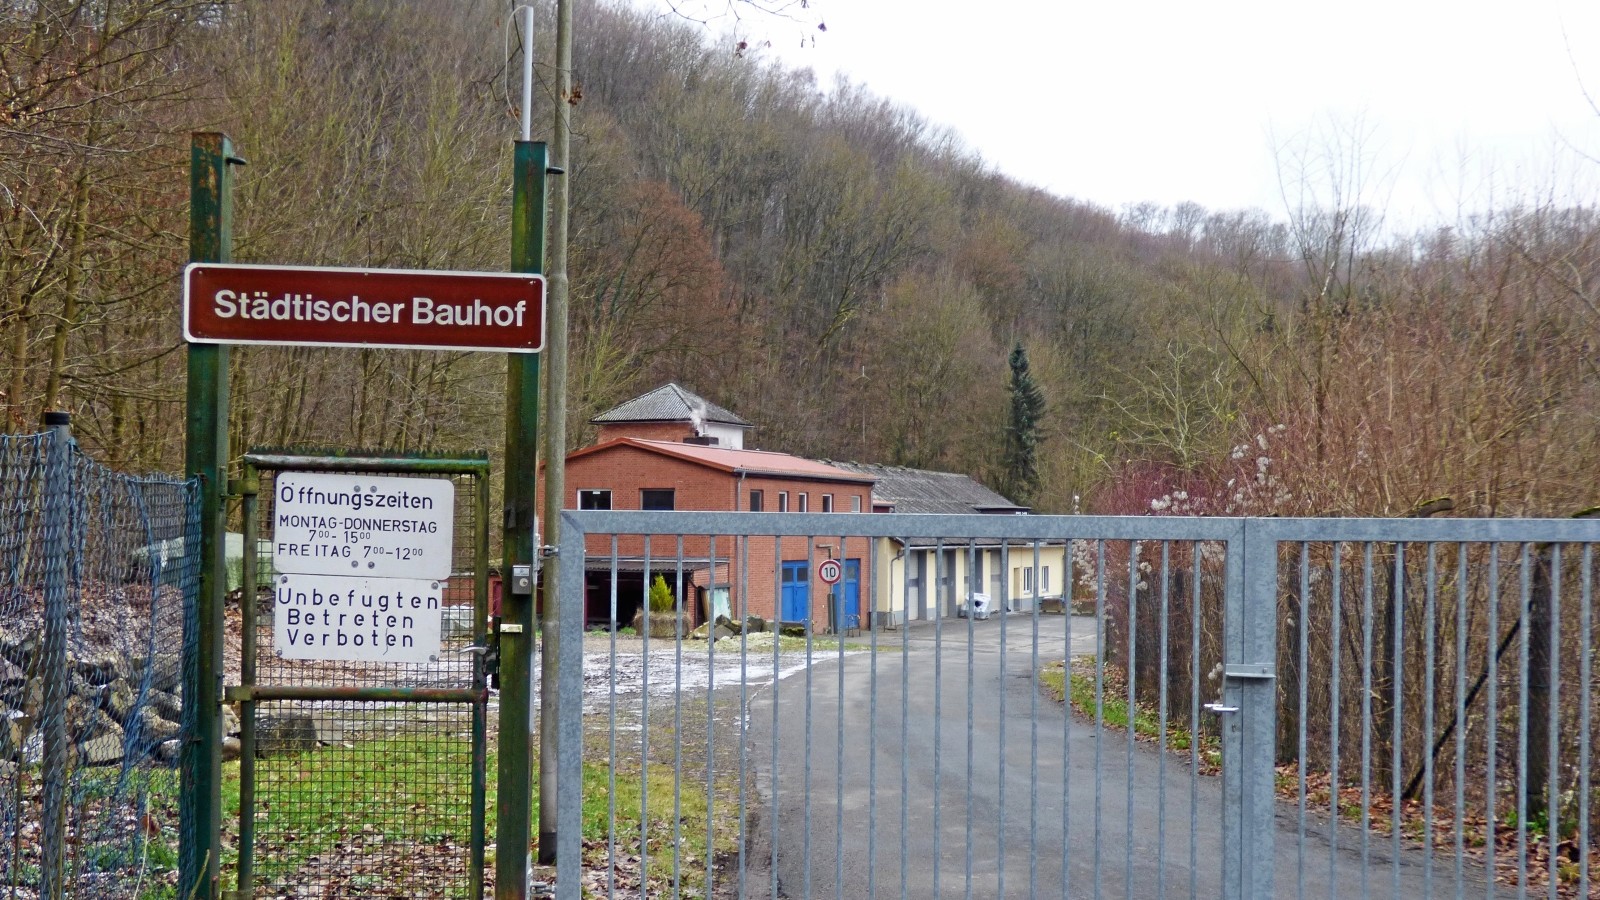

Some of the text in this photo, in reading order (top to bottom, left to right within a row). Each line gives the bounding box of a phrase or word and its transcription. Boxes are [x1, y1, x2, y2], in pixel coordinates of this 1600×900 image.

[214, 289, 527, 327] Städtischer Bauhof
[281, 481, 433, 511] Öffnungszeiten
[279, 514, 438, 534] MONTAG-DONNERSTAG
[278, 543, 352, 558] FREITAG
[825, 567, 836, 578] 10
[278, 587, 438, 612] Unbefugten
[287, 608, 414, 629] Betreten
[287, 628, 413, 648] Verboten
